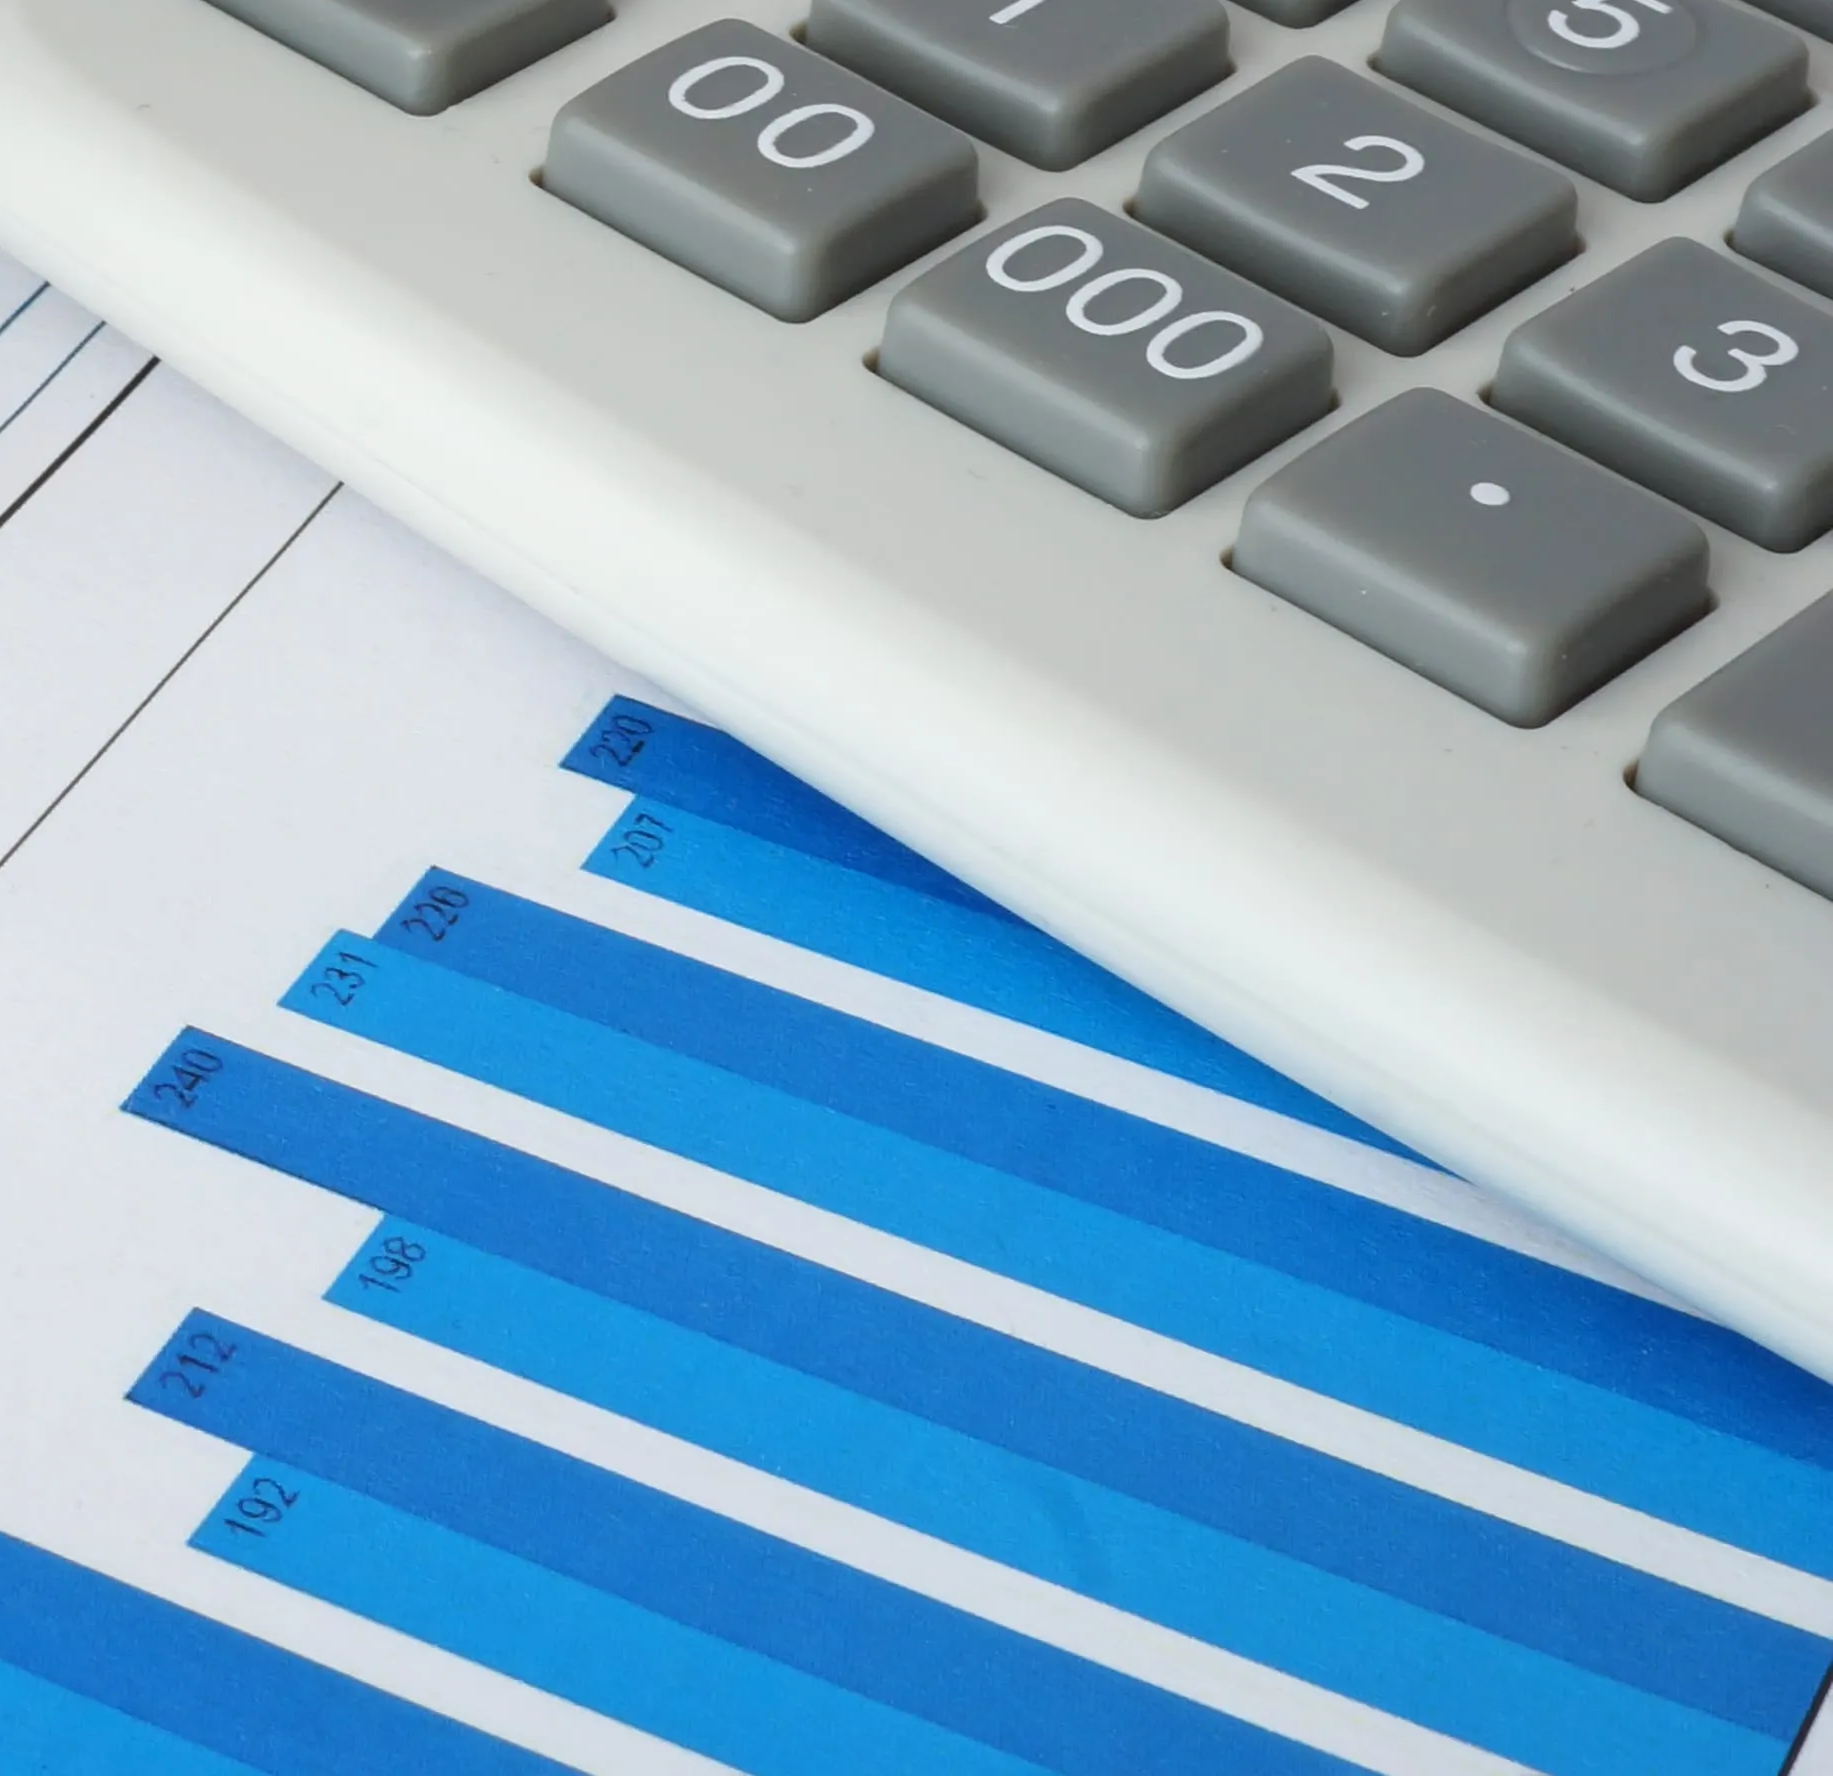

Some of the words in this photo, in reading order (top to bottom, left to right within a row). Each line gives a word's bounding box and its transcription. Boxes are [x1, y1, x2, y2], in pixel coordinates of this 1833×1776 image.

[666, 54, 876, 169] 00
[1289, 133, 1428, 210] 2
[984, 225, 1265, 381] 000
[1673, 319, 1800, 393] 3
[589, 714, 655, 768] 220
[610, 812, 675, 869] 207
[309, 950, 380, 1007] 231
[153, 1047, 224, 1109] 240
[357, 1236, 427, 1294] 198
[158, 1332, 238, 1400] 212
[223, 1477, 301, 1538] 192
